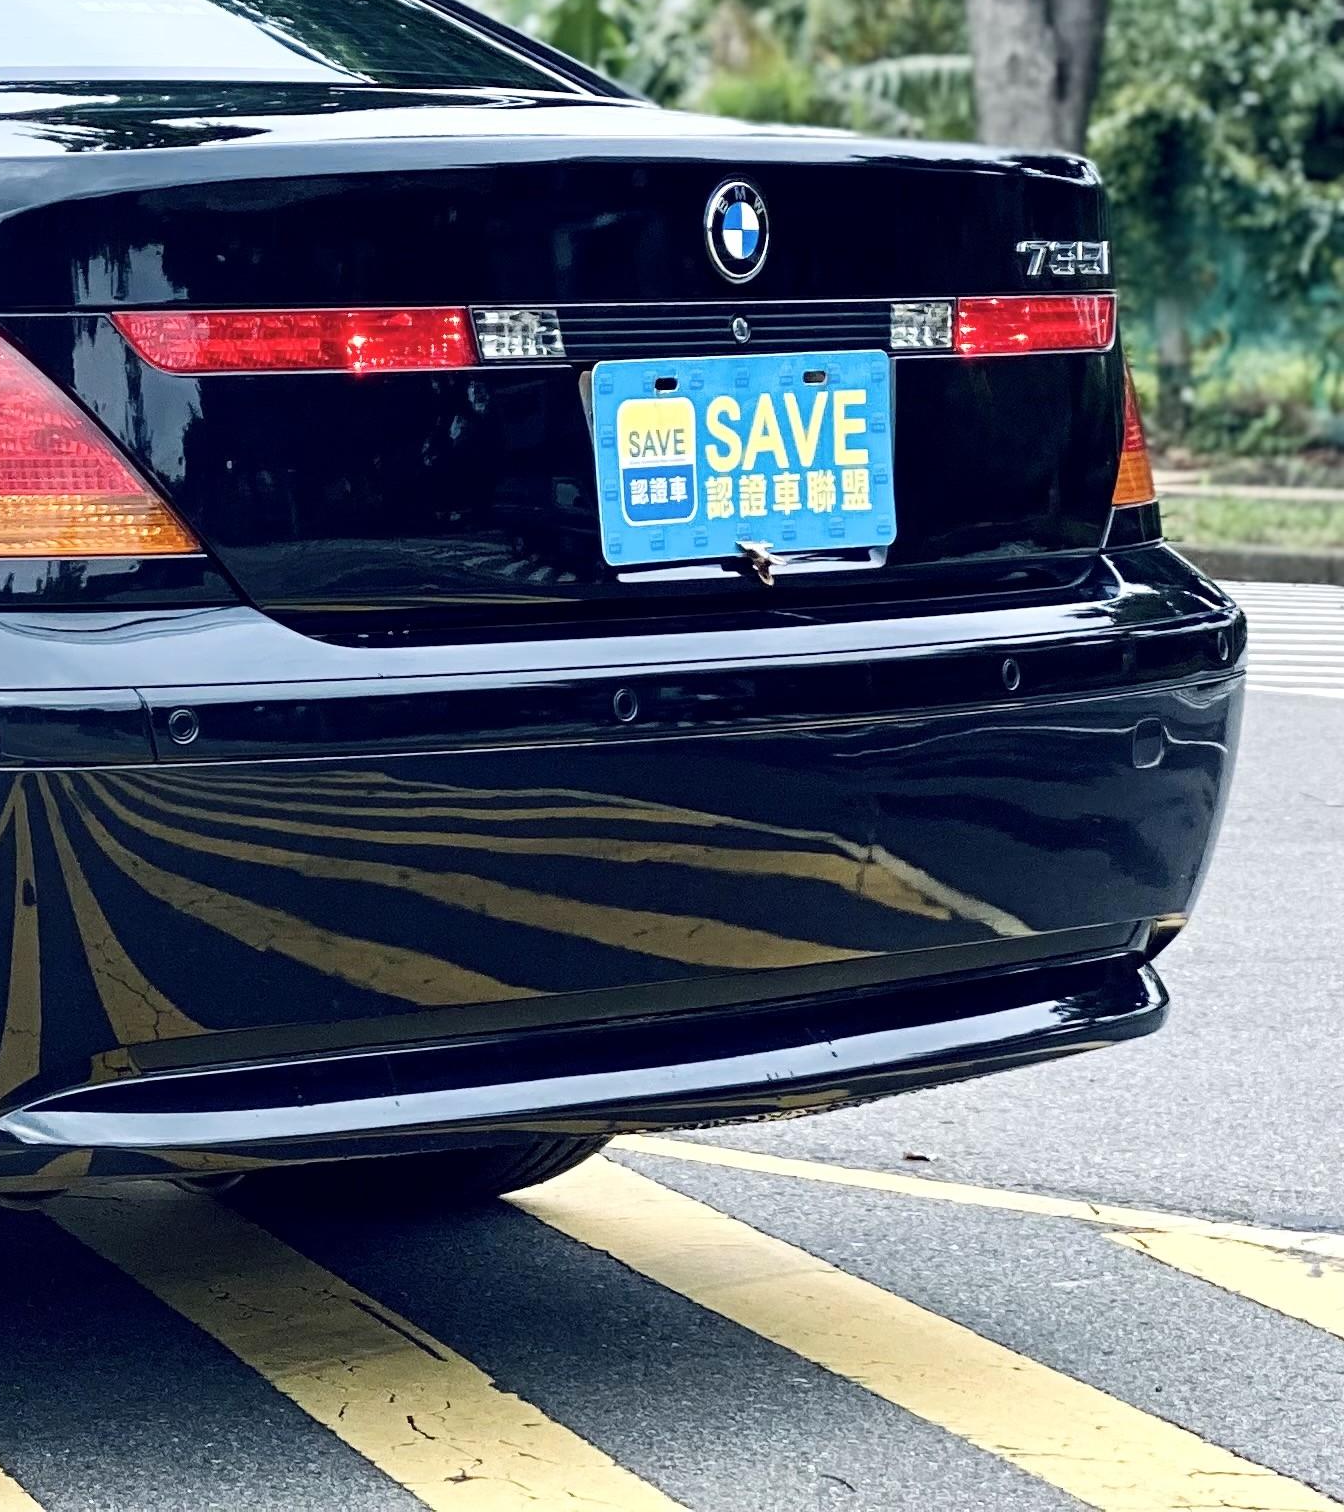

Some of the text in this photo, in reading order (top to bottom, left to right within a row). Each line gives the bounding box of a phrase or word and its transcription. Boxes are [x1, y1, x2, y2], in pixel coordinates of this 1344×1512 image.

[718, 186, 764, 215] BMW
[629, 428, 686, 458] SAVE
[705, 389, 869, 472] SAVE
[630, 476, 688, 506] 認證車
[705, 468, 873, 520] 認證車聯盟
